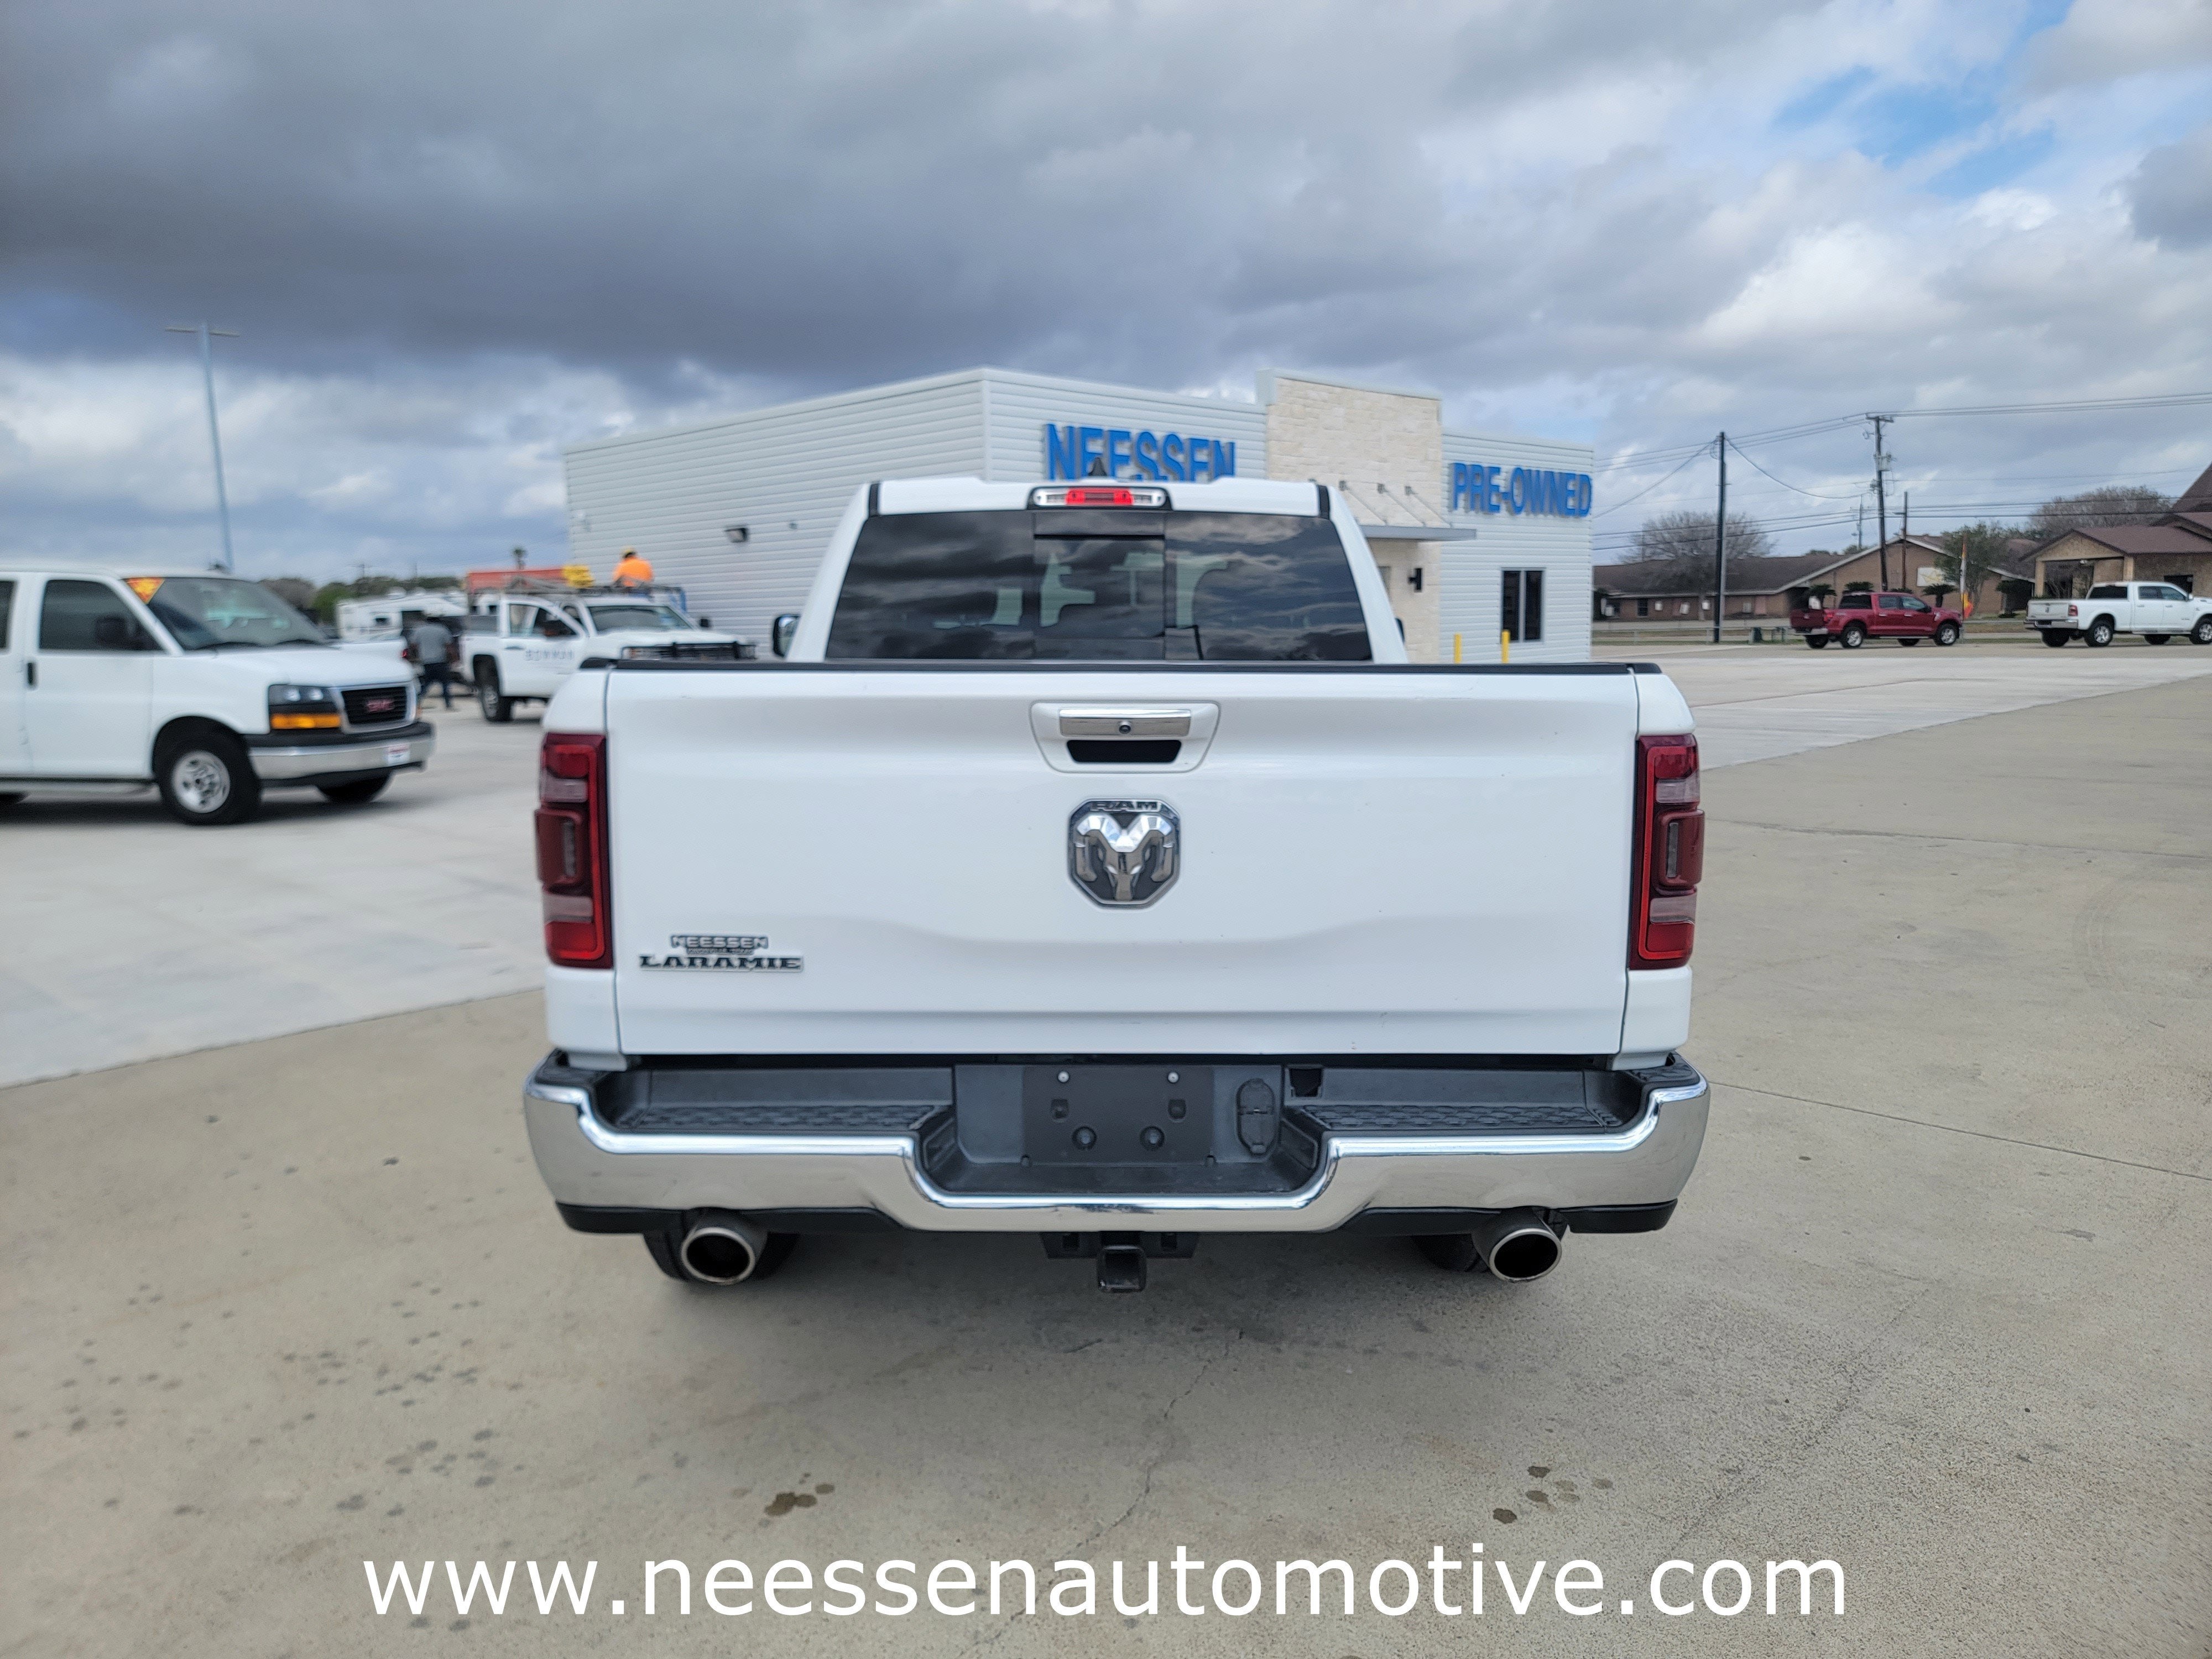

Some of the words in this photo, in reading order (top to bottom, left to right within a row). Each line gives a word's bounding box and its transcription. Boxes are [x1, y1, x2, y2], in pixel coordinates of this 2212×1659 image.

[1453, 462, 1593, 517] PRE-OWNED
[1091, 801, 1160, 812] RAM
[671, 935, 768, 948] NEESSEN
[639, 956, 803, 972] LARAMIE
